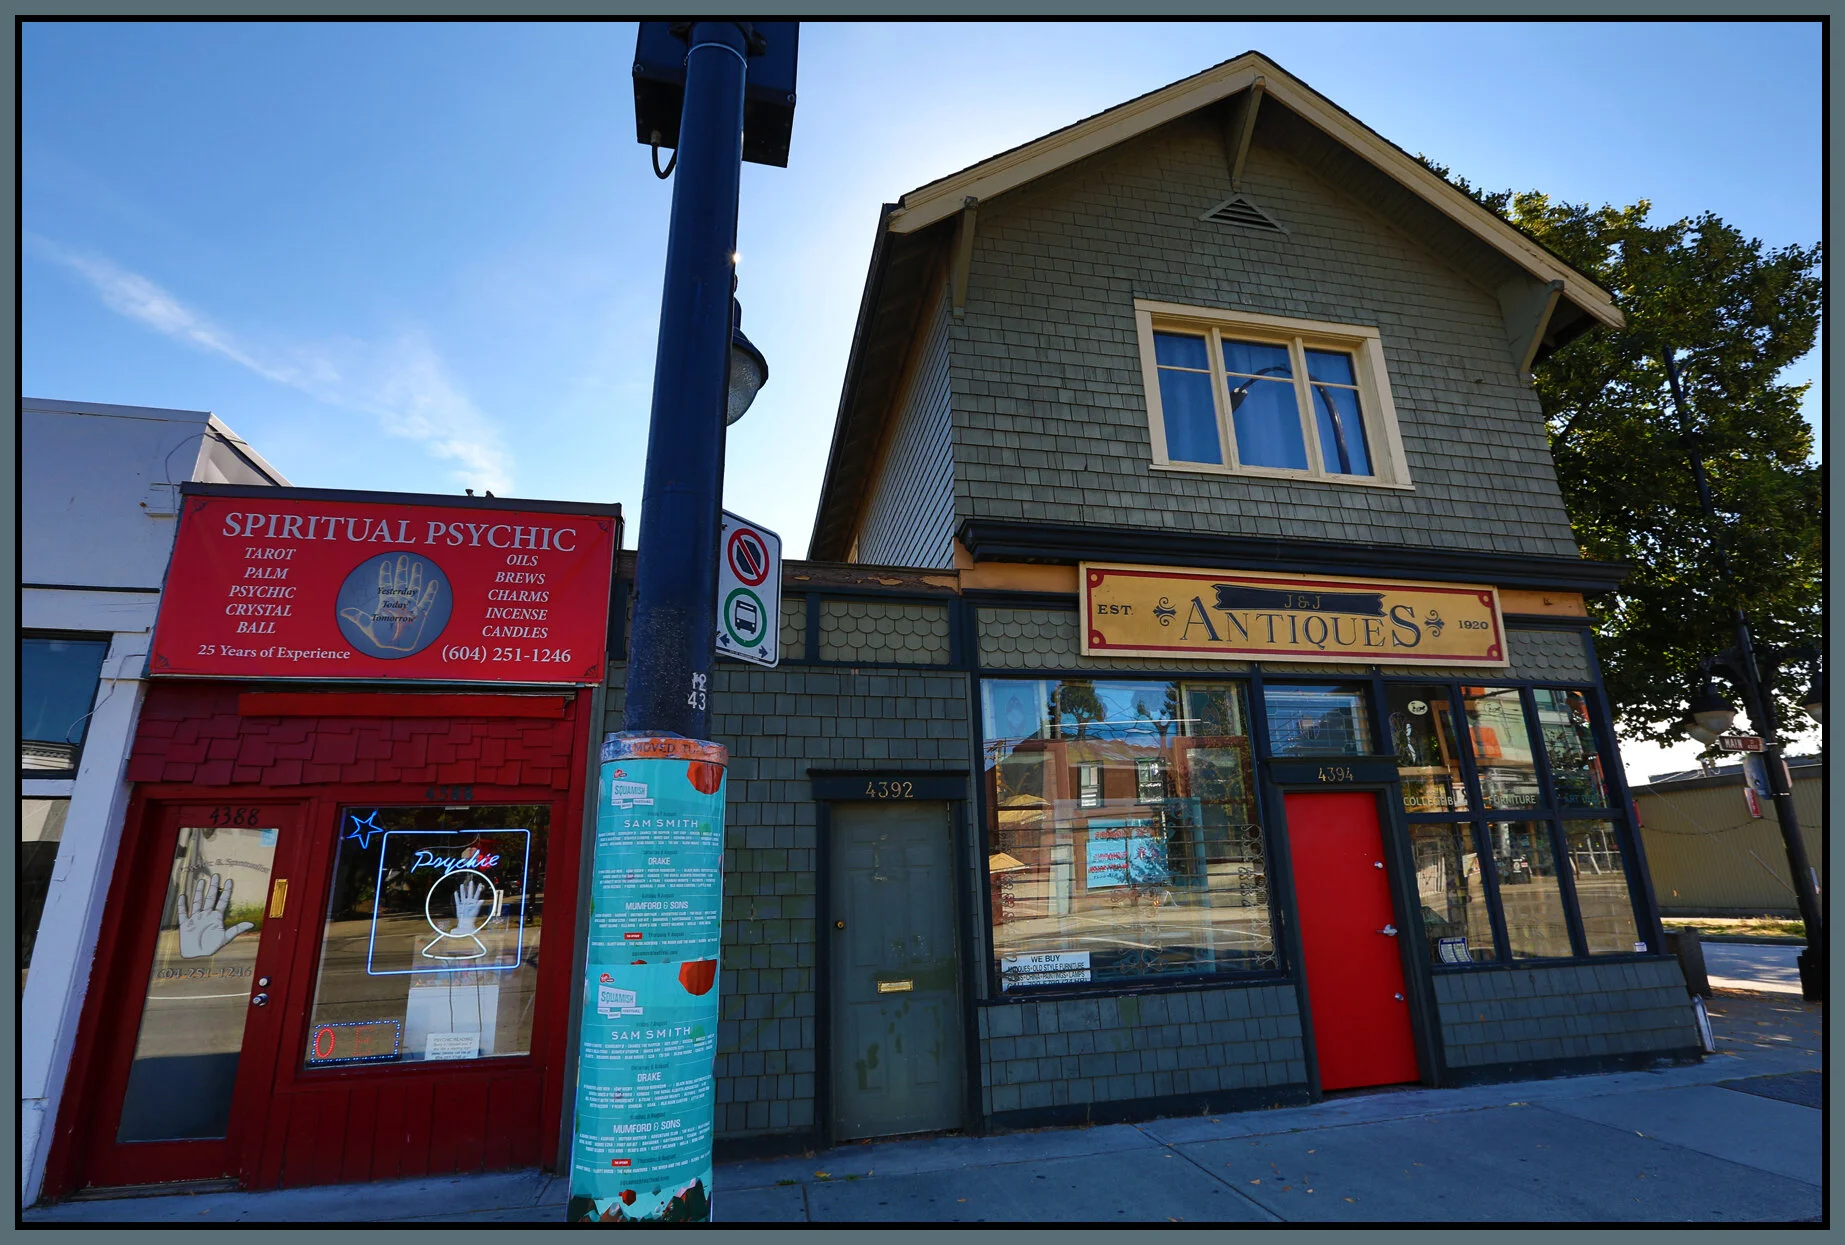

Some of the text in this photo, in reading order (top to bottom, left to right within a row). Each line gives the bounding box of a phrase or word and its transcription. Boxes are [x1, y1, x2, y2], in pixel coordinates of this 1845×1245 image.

[222, 513, 577, 552] SPIRITUAL PSYCHIC
[244, 547, 296, 561] TAROT
[506, 554, 538, 567] OILS
[243, 567, 288, 580] PALM
[495, 572, 546, 585] BREWS
[228, 585, 296, 599] PSYCHIC
[377, 587, 417, 597] Yesterday
[487, 589, 549, 603] CHARMS
[383, 600, 410, 611] Today
[1284, 594, 1321, 610] J&J
[225, 603, 292, 617] CRYSTAL
[485, 607, 547, 621] INCENSE
[1097, 603, 1134, 616] EST.
[371, 613, 417, 623] Tomorrow
[1180, 596, 1422, 650] ANTIQUES
[236, 621, 276, 634] BALL
[1458, 619, 1489, 631] 1920
[482, 625, 548, 639] CANDLES
[198, 644, 351, 662] 25 Years of Experience
[442, 645, 571, 663] (604) 251-1246
[688, 691, 706, 710] 43
[1724, 738, 1744, 749] MAIN
[1318, 767, 1354, 782] 4394
[614, 784, 645, 797] SQUAMISH
[865, 781, 914, 798] 4392
[1488, 794, 1537, 805] FURNITURE
[209, 806, 260, 826] 4388
[624, 819, 698, 828] SAM SMITH
[648, 857, 671, 866] DRAKE
[625, 901, 689, 911] MUMFORD & SONS
[1044, 963, 1058, 971] STYLE
[1059, 962, 1084, 970] FURNITURE
[1042, 972, 1067, 980] PAINTINGS
[1068, 970, 1085, 978] LAMPS
[600, 991, 634, 1003] SQUAMISH
[611, 1026, 691, 1041] SAM SMITH
[637, 1072, 661, 1083] DRAKE
[613, 1119, 681, 1134] MUMFORD & SONS
